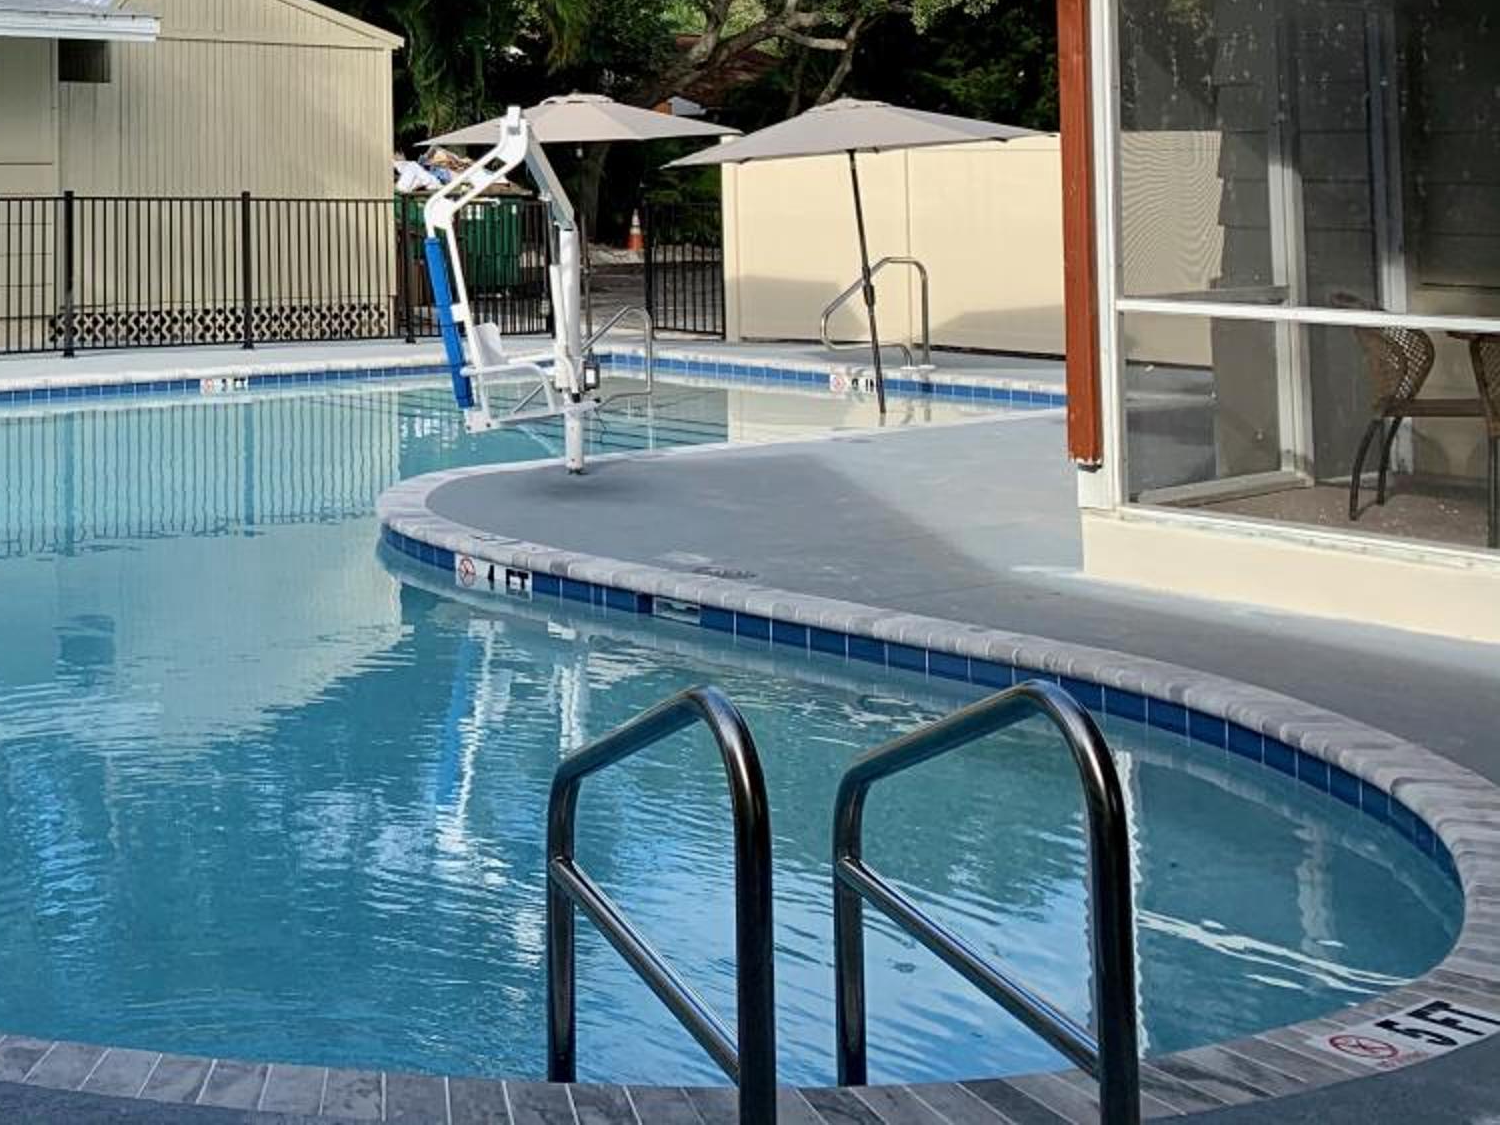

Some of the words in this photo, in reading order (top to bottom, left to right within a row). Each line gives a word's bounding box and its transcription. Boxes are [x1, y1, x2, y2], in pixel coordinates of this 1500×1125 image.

[233, 377, 246, 391] FT
[506, 568, 529, 591] FT
[1406, 1000, 1500, 1036] FT
[1374, 1019, 1458, 1046] 5
